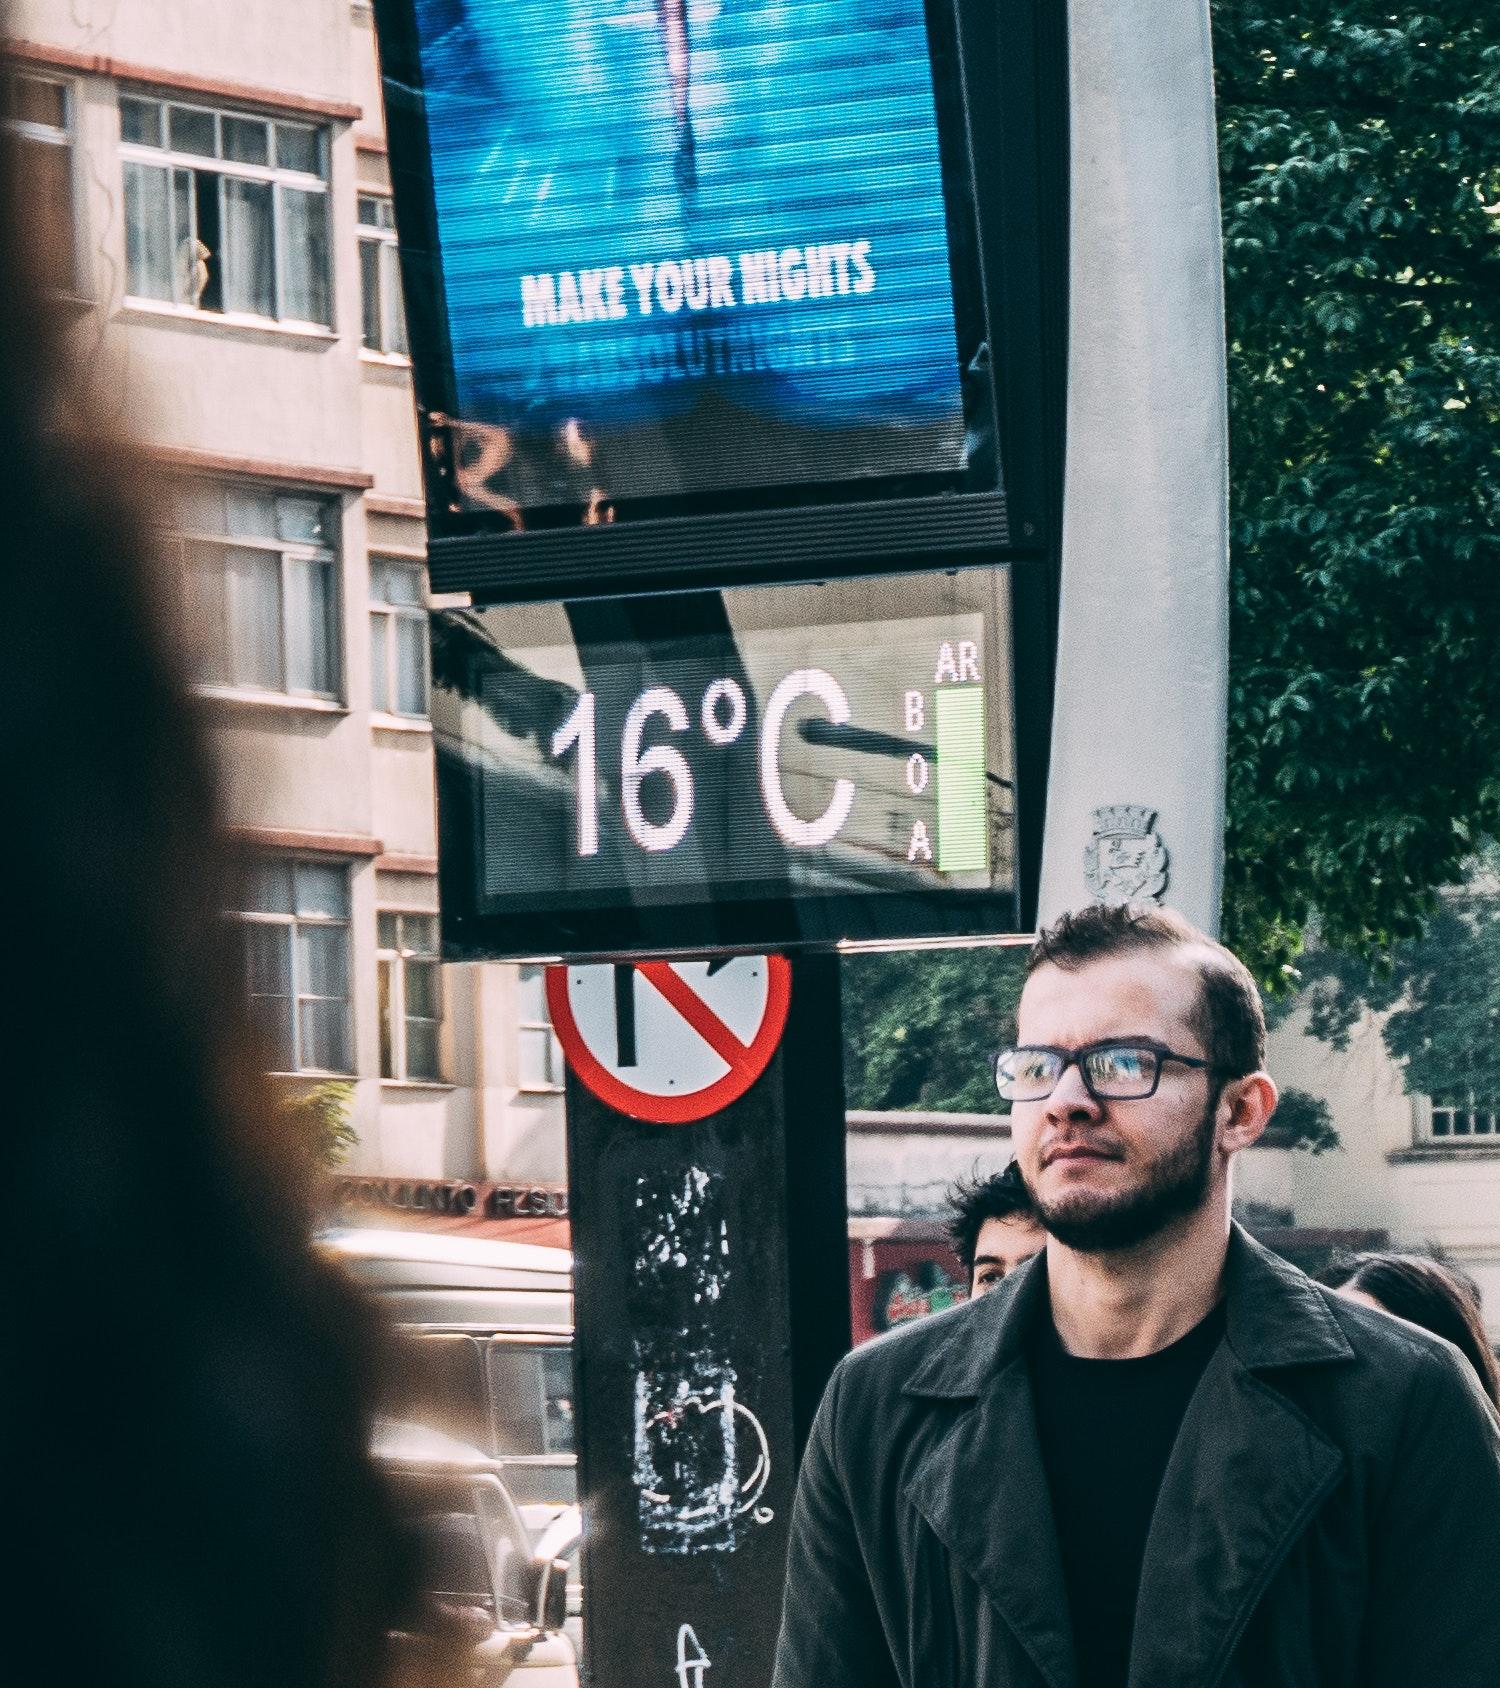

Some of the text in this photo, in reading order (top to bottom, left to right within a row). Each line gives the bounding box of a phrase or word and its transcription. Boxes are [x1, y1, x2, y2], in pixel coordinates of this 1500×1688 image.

[519, 239, 877, 328] MAKE YOUR NIGHTS
[935, 641, 978, 683] AR
